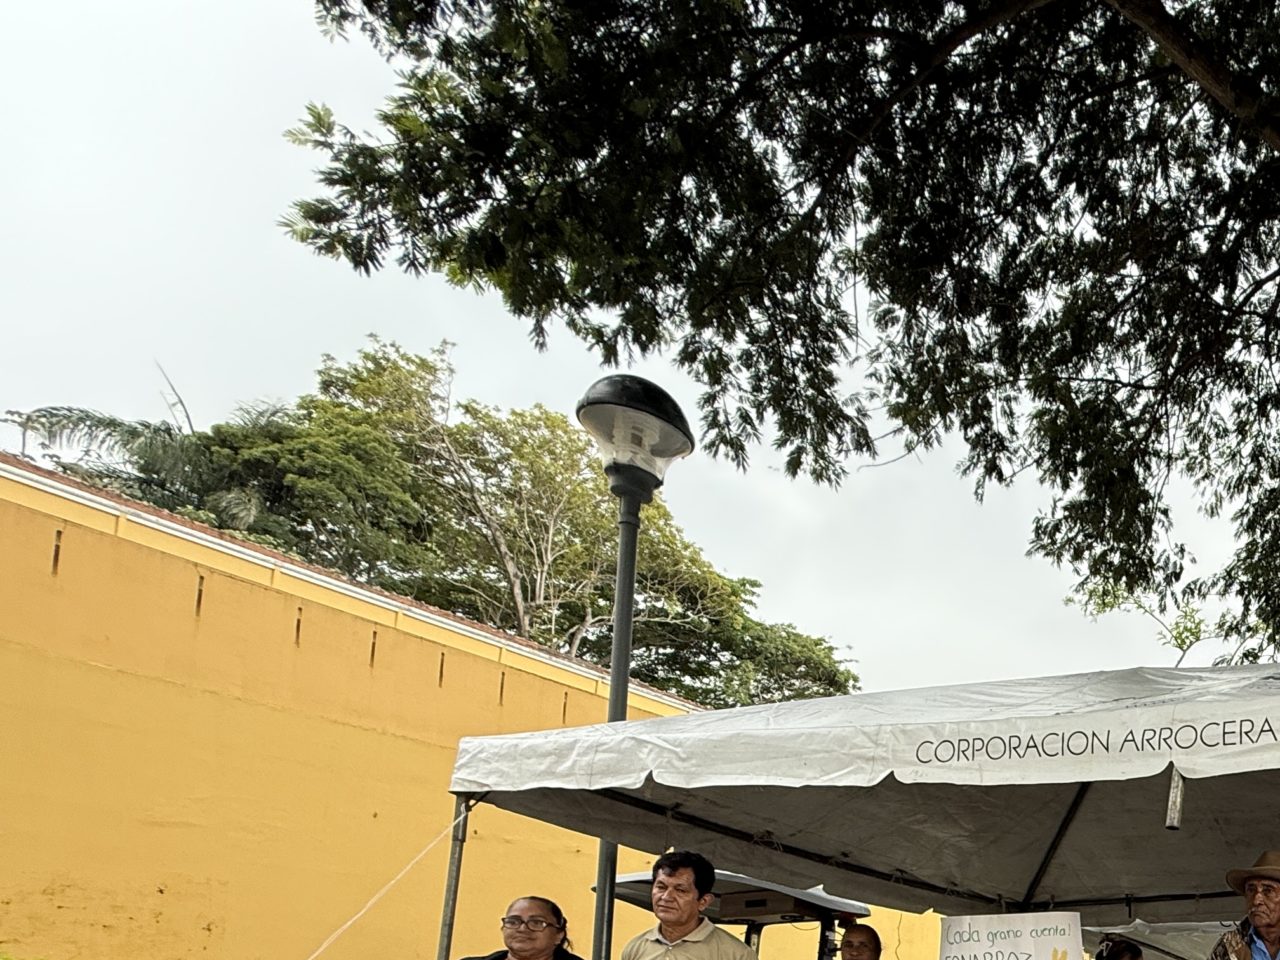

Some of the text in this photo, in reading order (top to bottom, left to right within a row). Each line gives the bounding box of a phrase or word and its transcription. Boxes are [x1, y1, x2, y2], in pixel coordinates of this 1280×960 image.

[916, 730, 1111, 764] CORPORACION
[1119, 717, 1278, 753] ARROCERA
[986, 929, 1023, 948] grano
[1029, 923, 1071, 939] cuenta!
